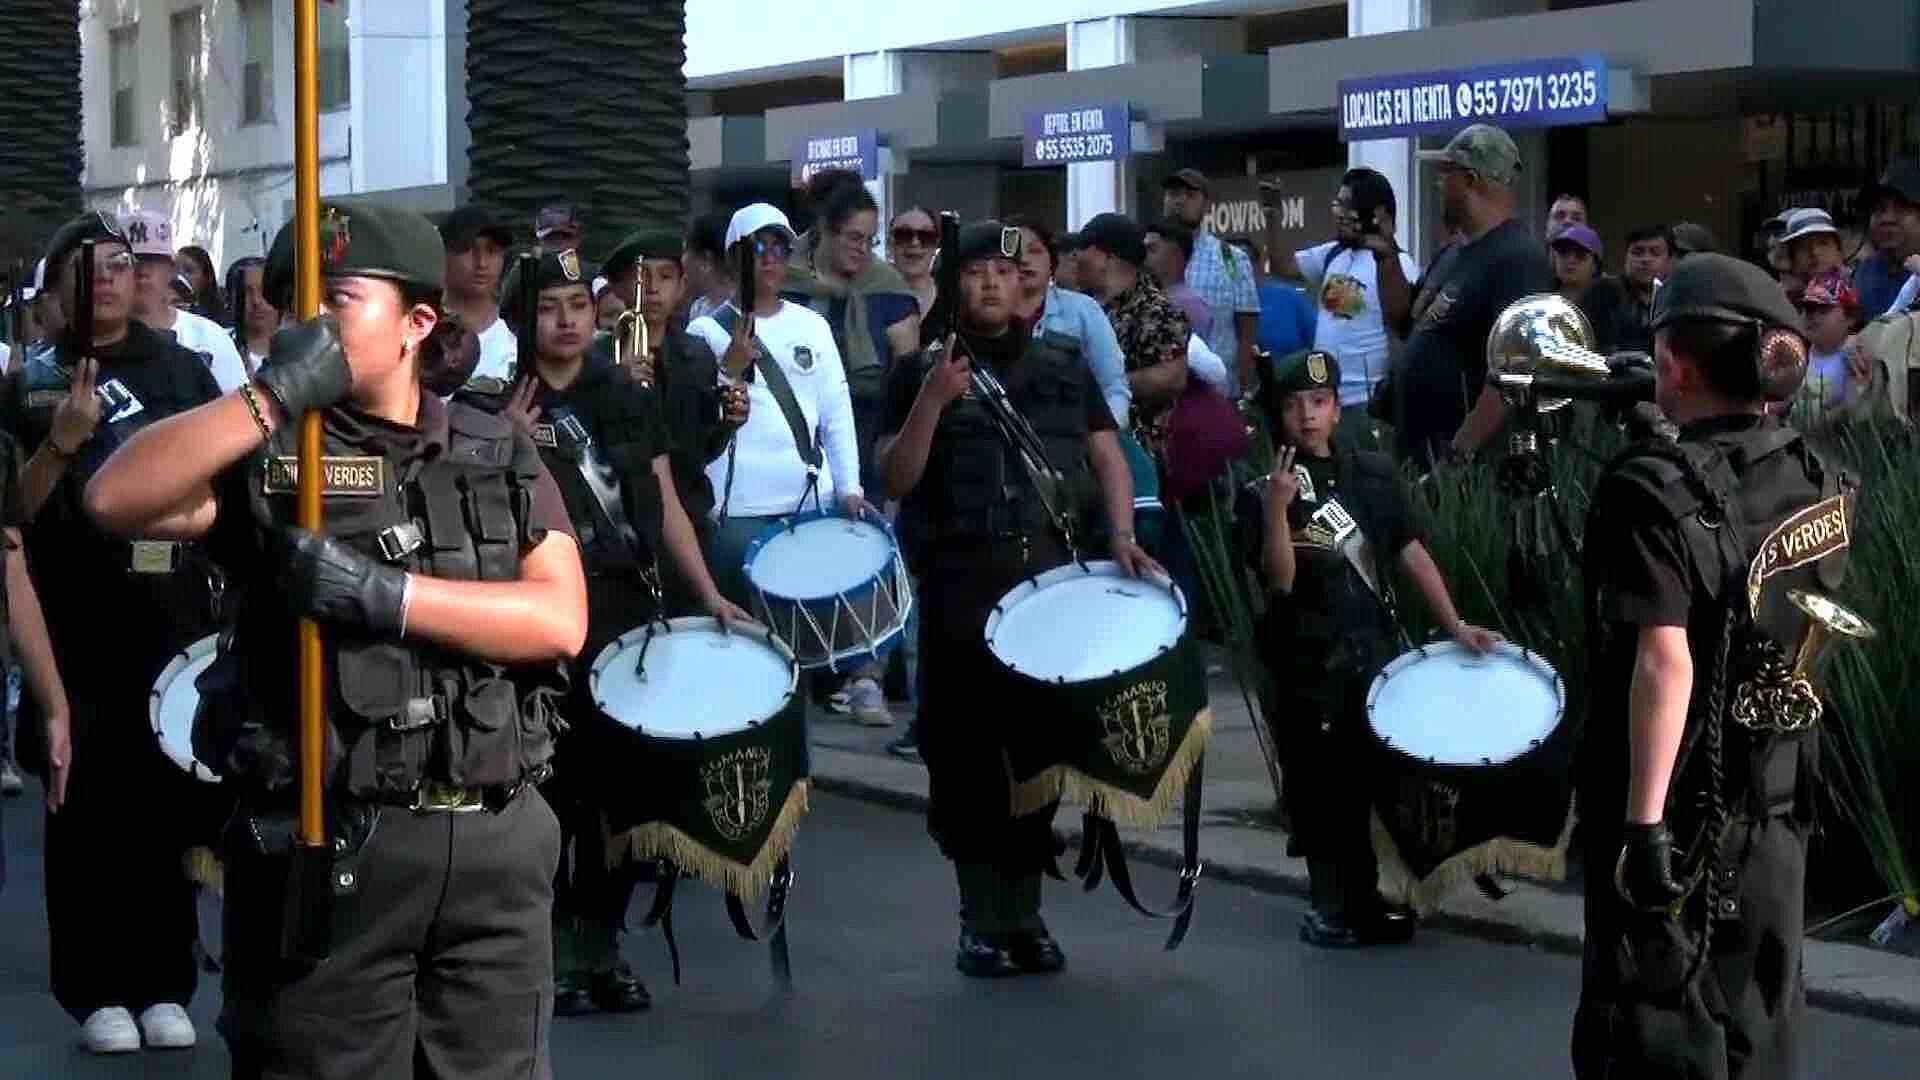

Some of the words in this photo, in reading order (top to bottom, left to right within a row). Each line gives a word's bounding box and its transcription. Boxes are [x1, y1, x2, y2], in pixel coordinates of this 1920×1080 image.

[1343, 88, 1392, 128] LOCALES
[1394, 88, 1410, 124] EN
[1413, 83, 1451, 121] RENTA
[1474, 79, 1497, 116] 55
[1500, 76, 1543, 114] 7971
[1547, 69, 1596, 109] 3235
[1045, 139, 1059, 159] 55
[1087, 134, 1113, 156] 2075
[323, 463, 376, 488] VERDES
[1781, 510, 1842, 559] VERDES
